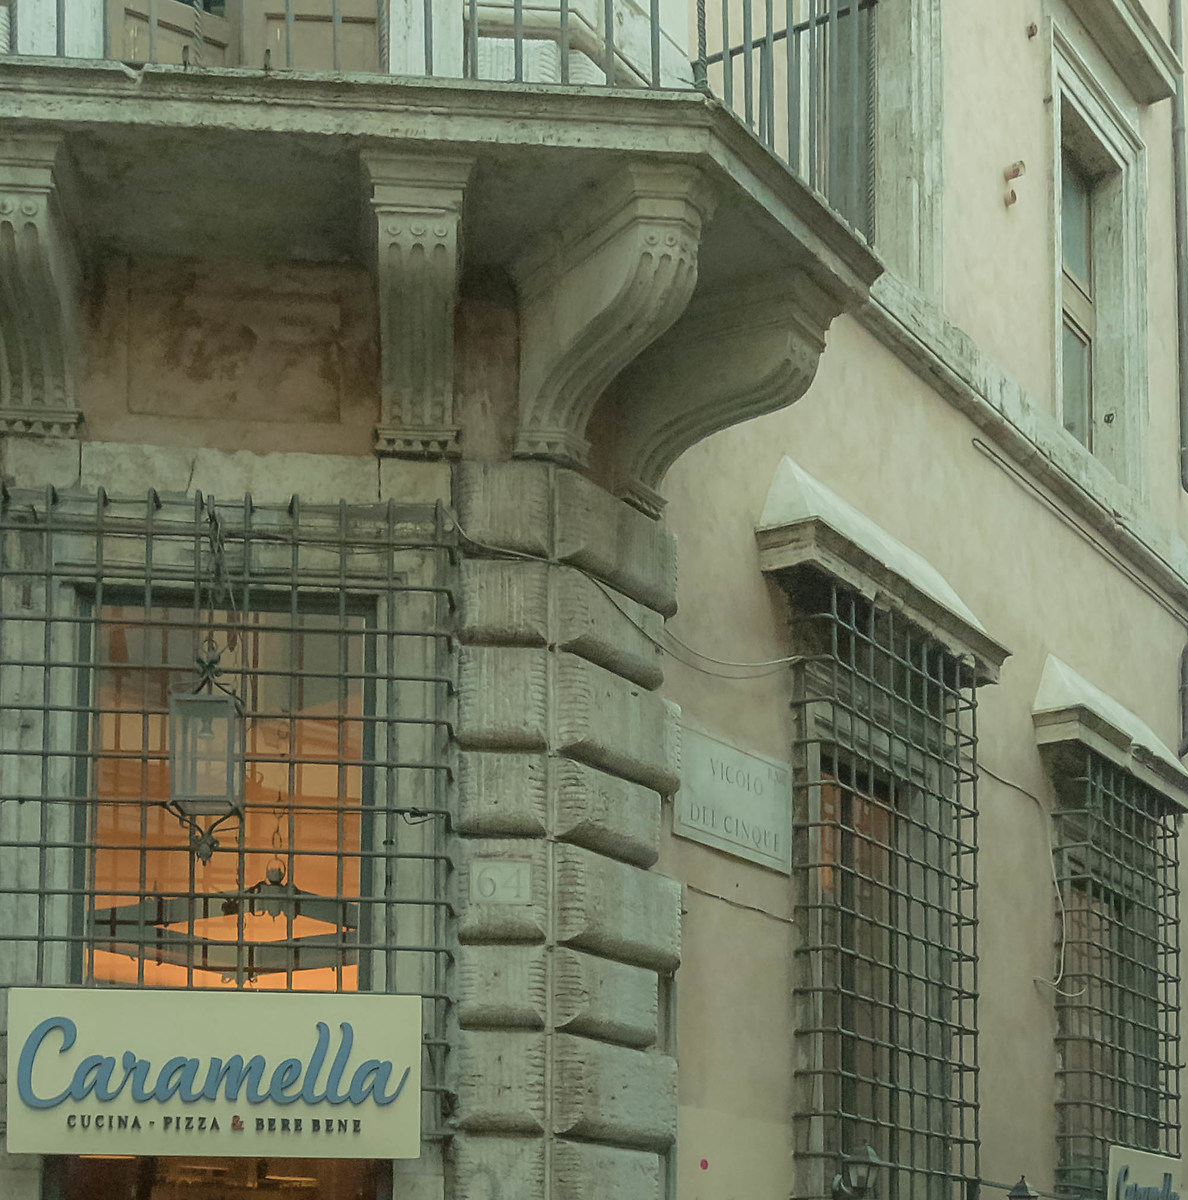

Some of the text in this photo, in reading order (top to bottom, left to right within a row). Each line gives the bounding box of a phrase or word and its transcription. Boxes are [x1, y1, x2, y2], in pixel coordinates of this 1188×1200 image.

[710, 758, 764, 796] VICOLO
[690, 802, 779, 852] DEL CINQUE
[477, 866, 527, 898] 64
[17, 1016, 411, 1110] Caramella
[66, 1114, 142, 1130] CUCINA
[163, 1115, 220, 1131] PIZZA
[231, 1115, 245, 1131] &
[255, 1117, 303, 1133] BERE
[311, 1118, 362, 1134] BENE
